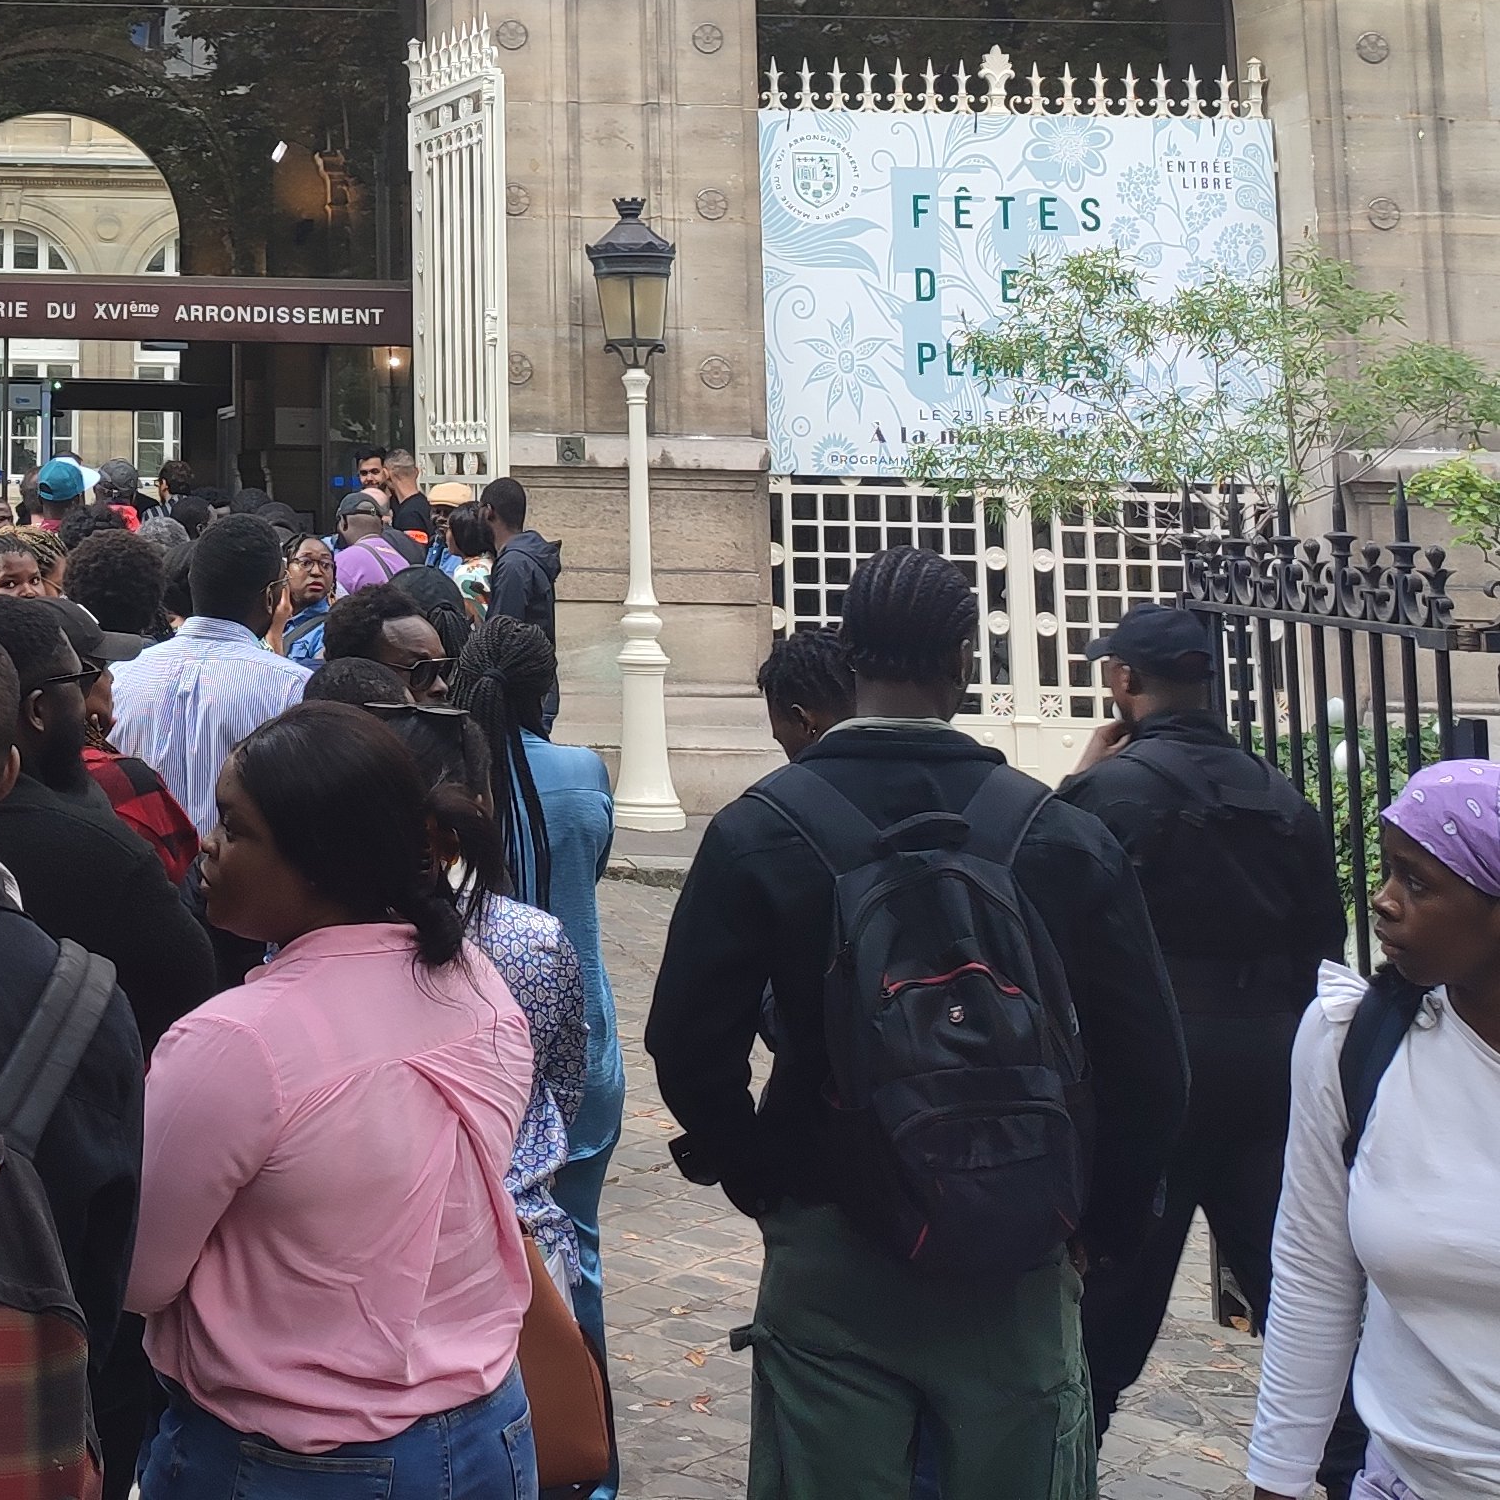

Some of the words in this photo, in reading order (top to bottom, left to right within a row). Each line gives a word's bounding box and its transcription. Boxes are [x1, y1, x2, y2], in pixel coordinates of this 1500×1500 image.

[1166, 158, 1232, 174] ENTRÉE
[1182, 176, 1233, 190] LIBRE
[912, 186, 1101, 232] FÊTES
[46, 302, 77, 320] DU
[174, 304, 386, 326] ARRONDISSEMENT
[919, 409, 941, 421] LE
[952, 410, 973, 422] 23
[870, 421, 887, 444] À
